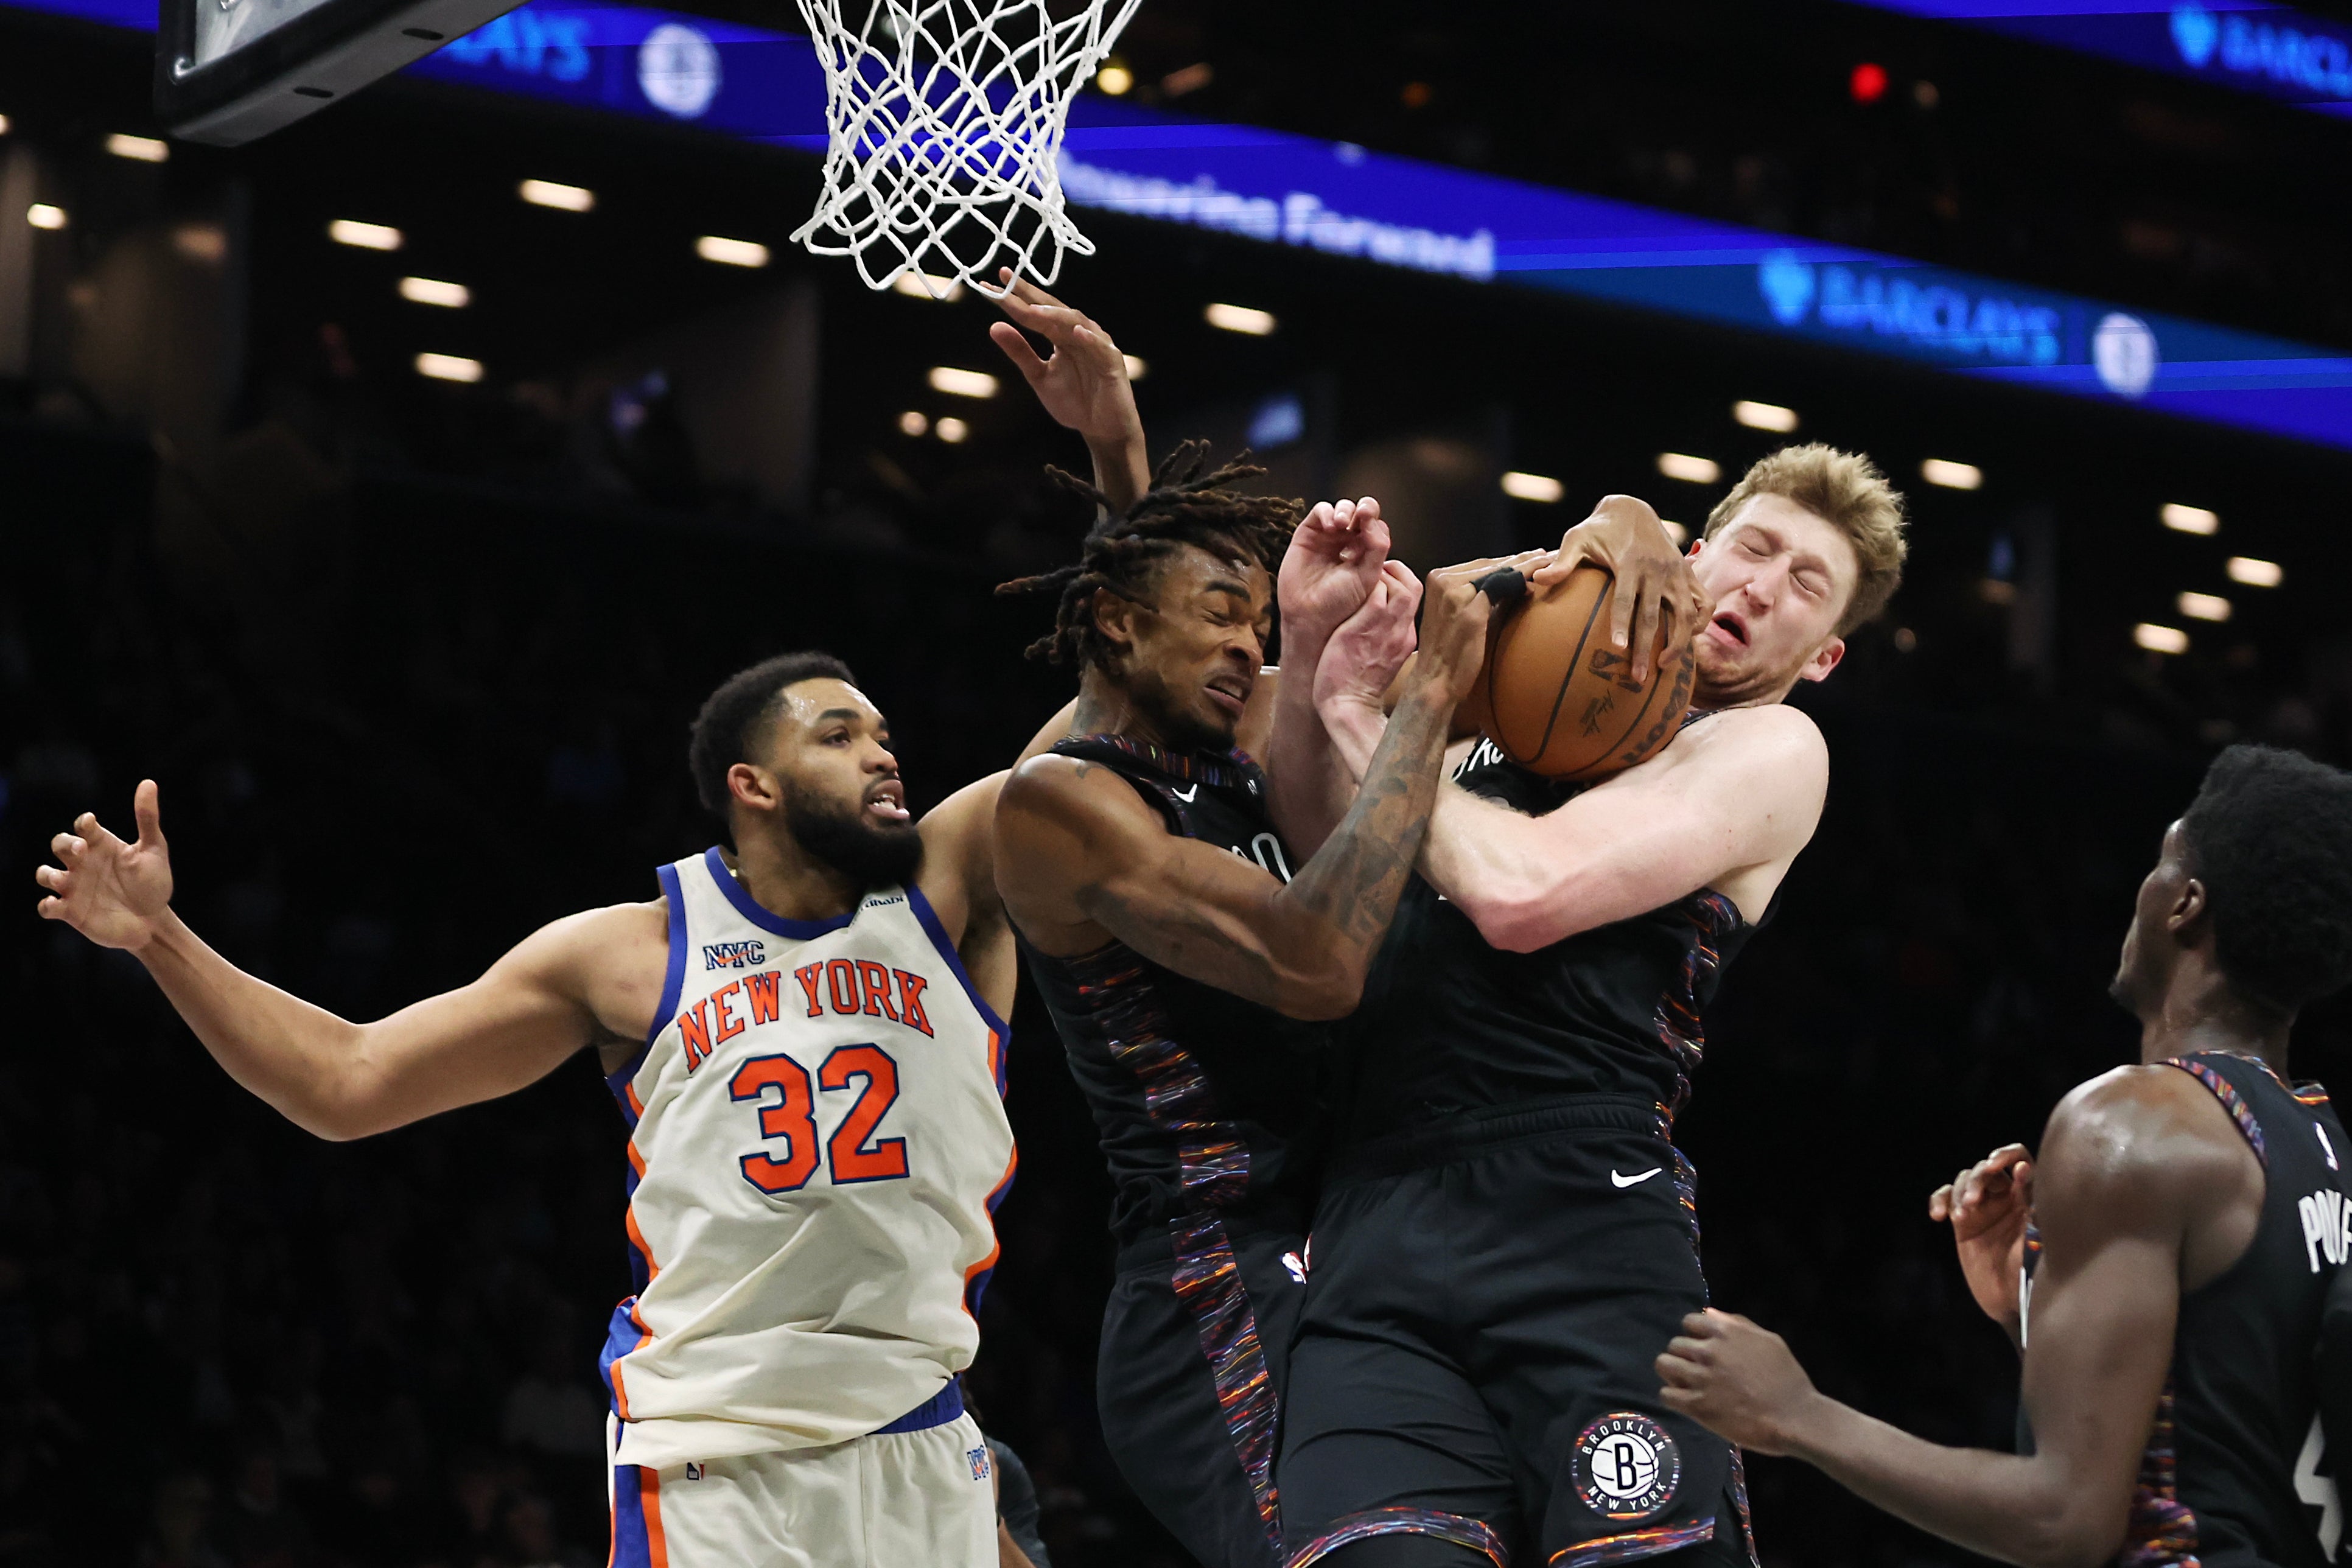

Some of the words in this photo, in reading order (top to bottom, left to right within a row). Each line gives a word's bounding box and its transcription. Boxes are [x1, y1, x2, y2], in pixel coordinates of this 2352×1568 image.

[703, 940, 765, 971] NYC
[677, 970, 781, 1074] NEW
[794, 959, 934, 1039] YORK
[729, 1042, 911, 1195] 32
[1581, 1420, 1665, 1455] BROOKLYN
[1614, 1443, 1637, 1490] B
[1587, 1485, 1620, 1510] NEW
[1629, 1482, 1667, 1510] YORK
